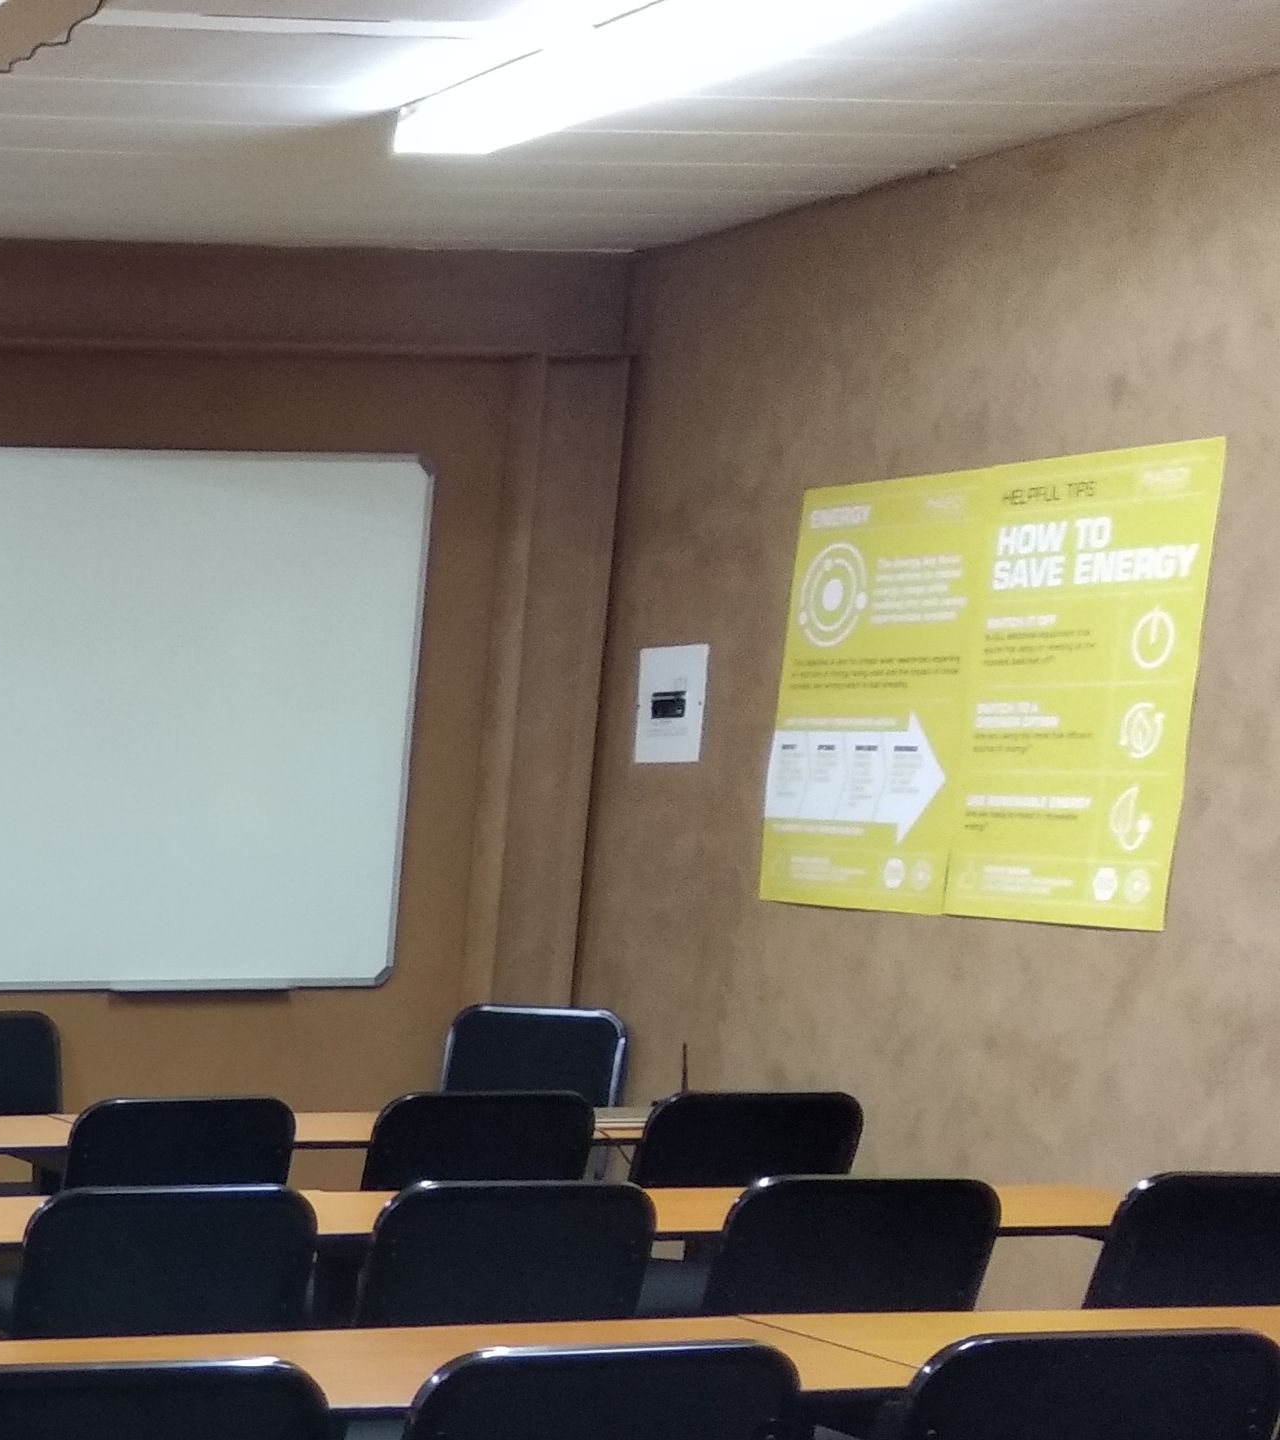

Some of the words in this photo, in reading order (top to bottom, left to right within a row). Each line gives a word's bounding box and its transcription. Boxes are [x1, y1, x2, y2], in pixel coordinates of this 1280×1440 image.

[1068, 480, 1097, 498] TIPS
[997, 520, 1068, 556] HOW
[1074, 515, 1112, 549] TO
[992, 555, 1065, 590] SAVE
[1073, 543, 1200, 584] ENERGY
